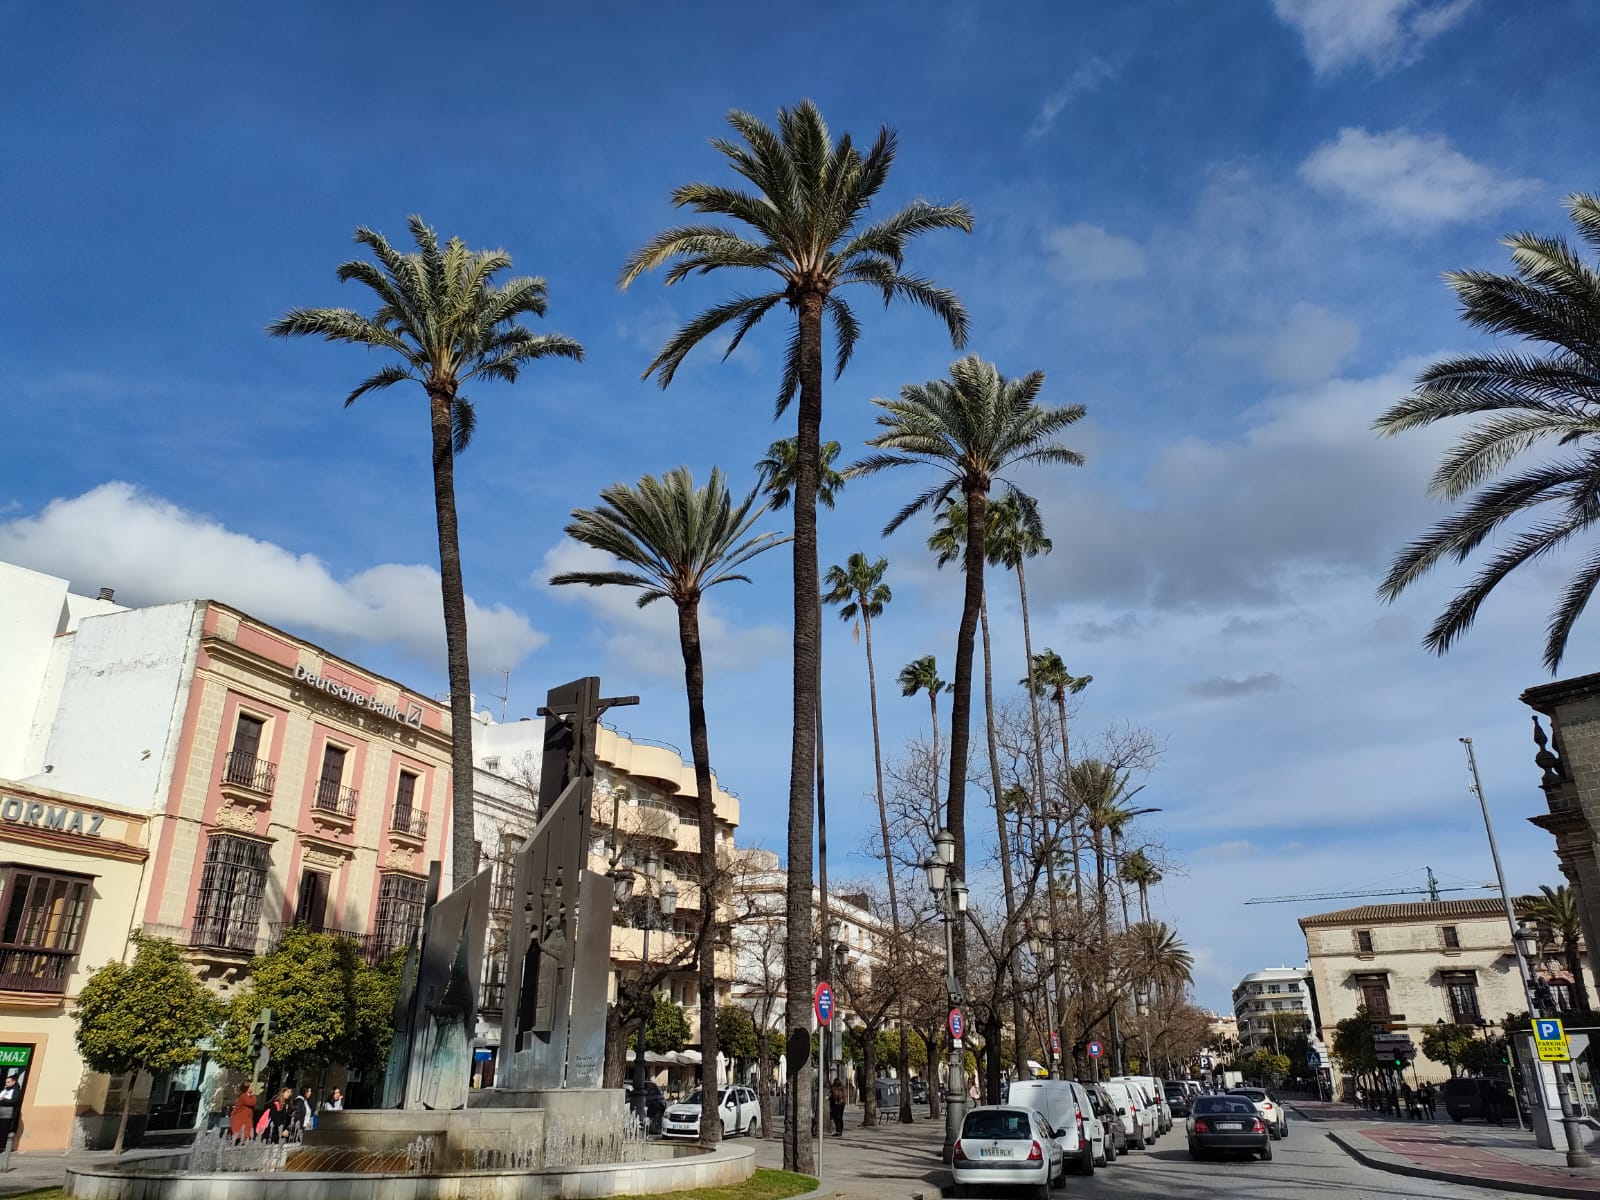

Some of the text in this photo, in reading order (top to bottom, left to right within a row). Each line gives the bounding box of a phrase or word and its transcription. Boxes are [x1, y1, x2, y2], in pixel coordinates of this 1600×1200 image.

[293, 663, 404, 724] Deutsche Bank
[0, 793, 104, 837] ORMAZ
[1541, 1023, 1554, 1038] P
